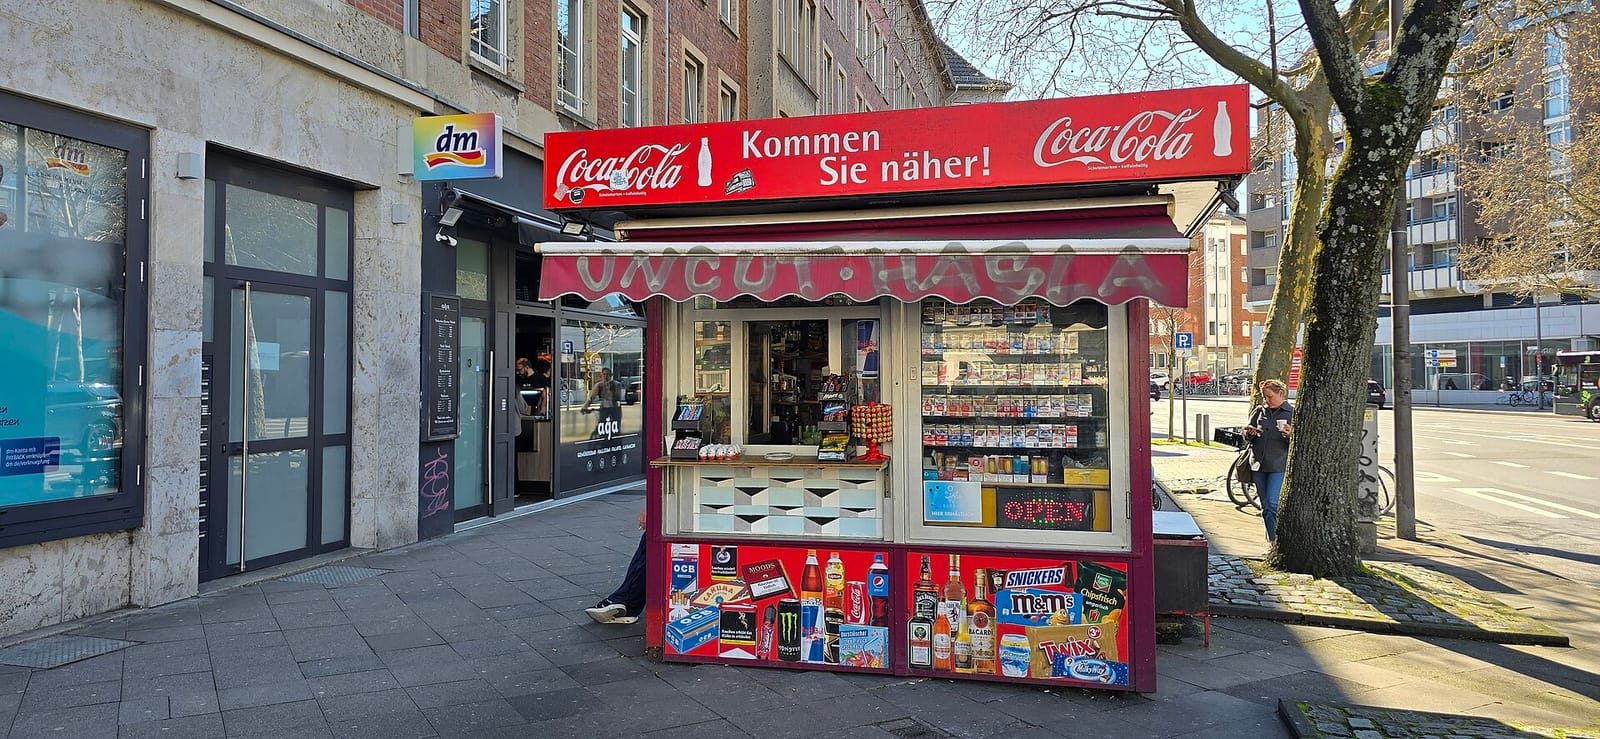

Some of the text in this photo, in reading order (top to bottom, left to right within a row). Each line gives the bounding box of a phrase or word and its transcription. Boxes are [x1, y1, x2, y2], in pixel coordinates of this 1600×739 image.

[436, 124, 478, 152] dm
[742, 129, 880, 160] Kommen
[1033, 107, 1204, 168] Coca-Cola
[556, 142, 691, 193] Coca-Cola
[819, 146, 990, 186] Sie näher!
[1004, 501, 1085, 522] OPEN
[674, 564, 696, 574] OCB
[749, 563, 776, 575] MOODS
[1007, 569, 1064, 587] SNICKERS
[1080, 588, 1117, 605] Chipsfrisch
